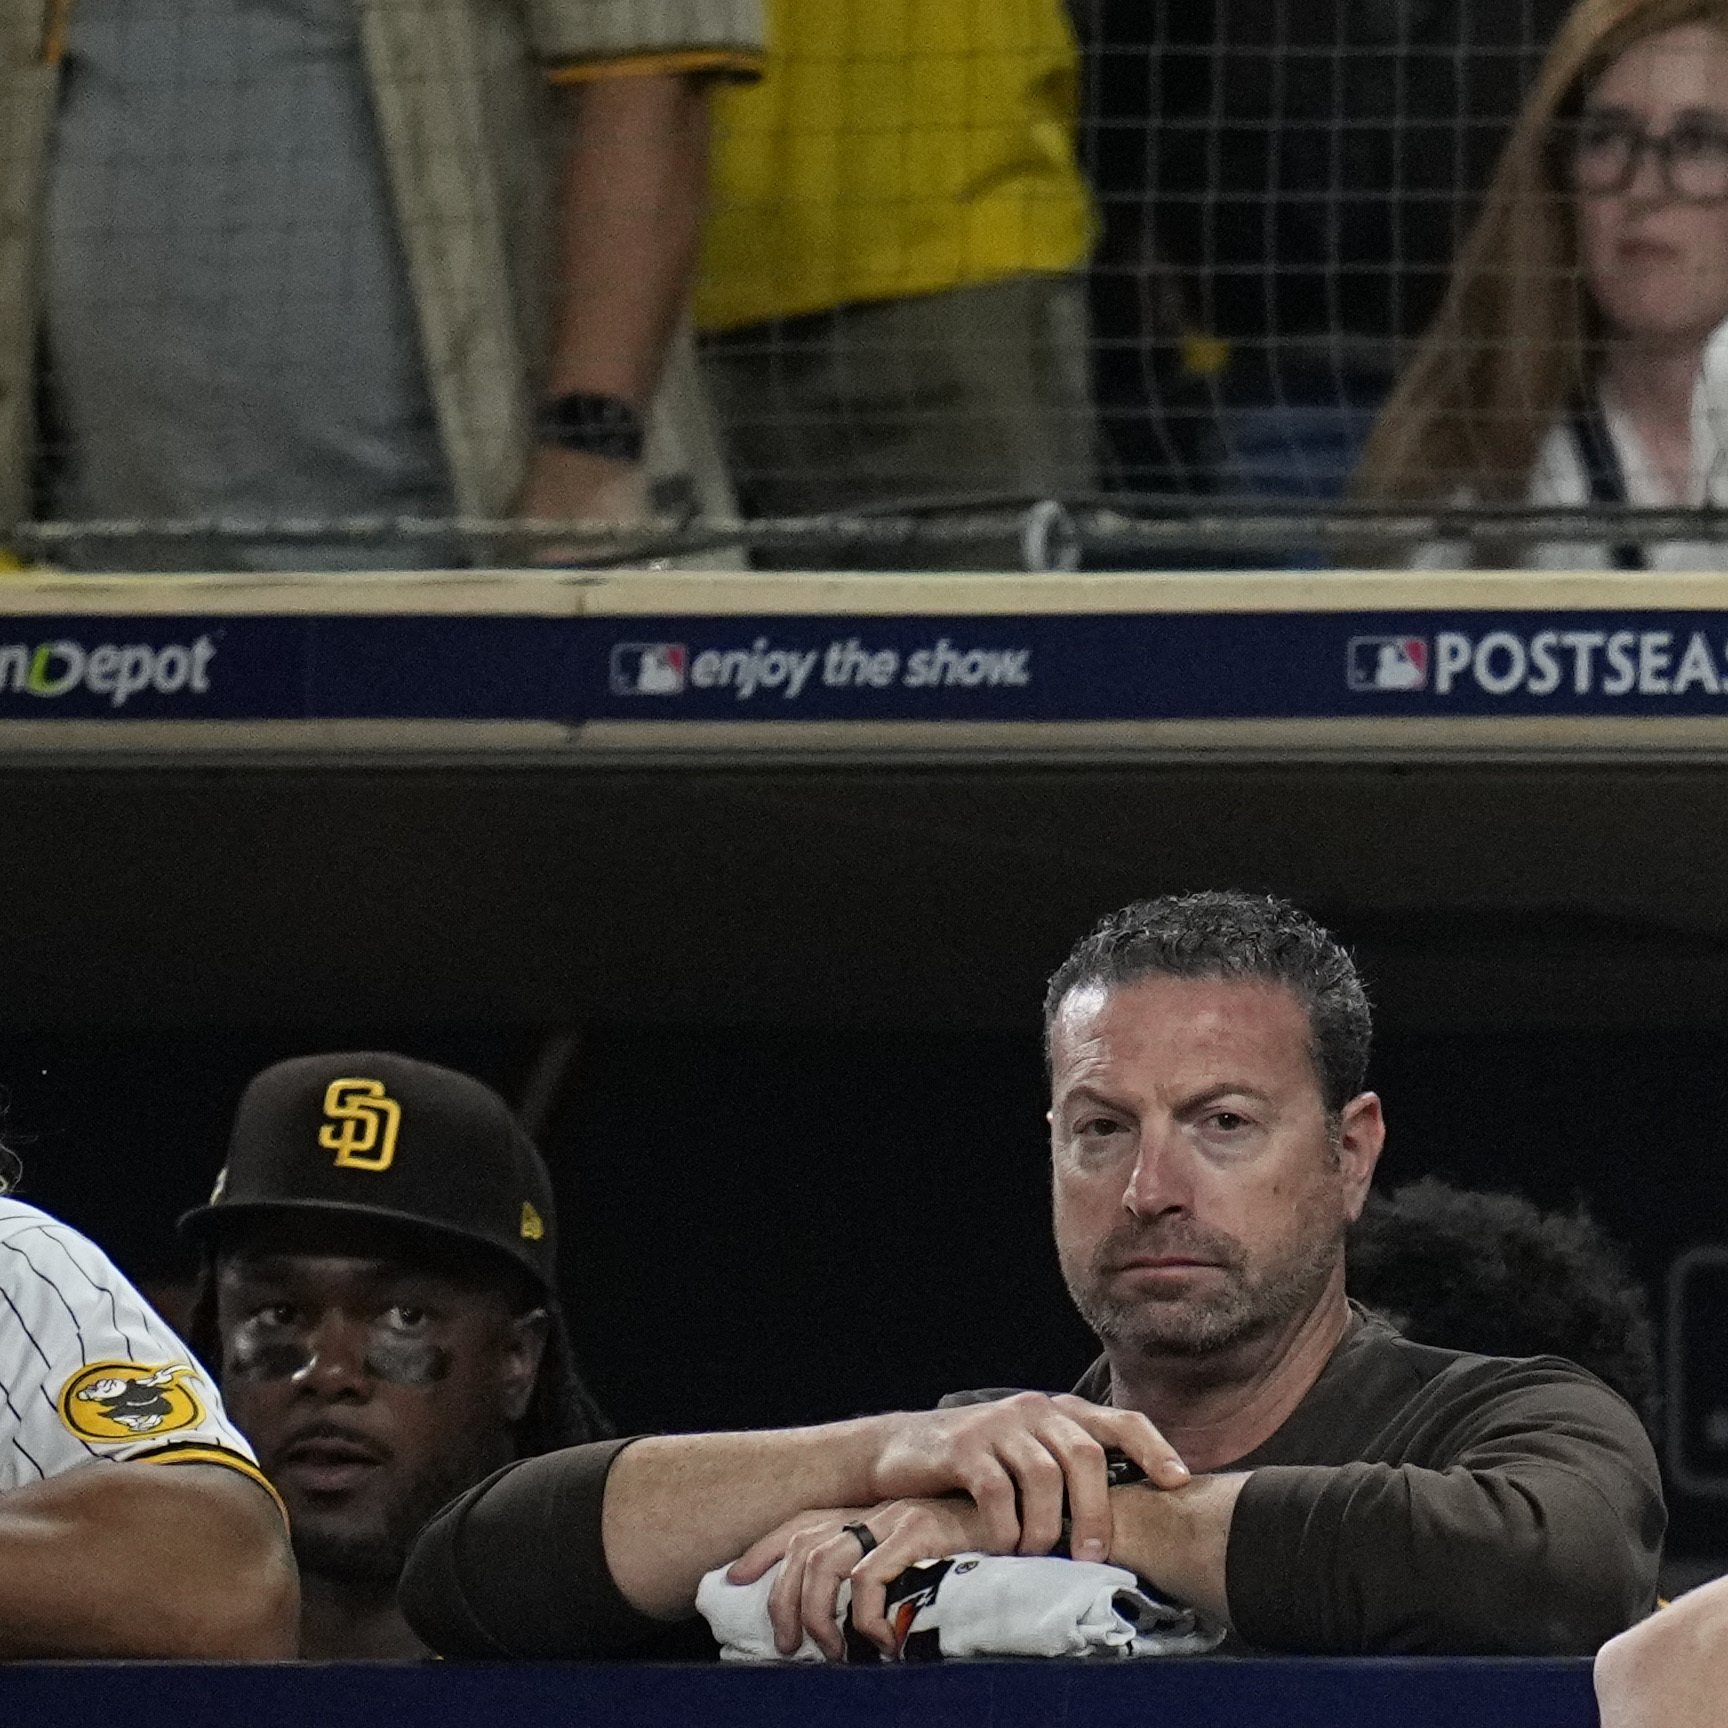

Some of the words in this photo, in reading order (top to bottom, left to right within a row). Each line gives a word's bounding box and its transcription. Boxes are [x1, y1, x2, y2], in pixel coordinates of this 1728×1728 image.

[691, 637, 817, 699] enjoy
[823, 637, 900, 688] the
[901, 637, 1030, 688] show.
[319, 1077, 401, 1172] SD
